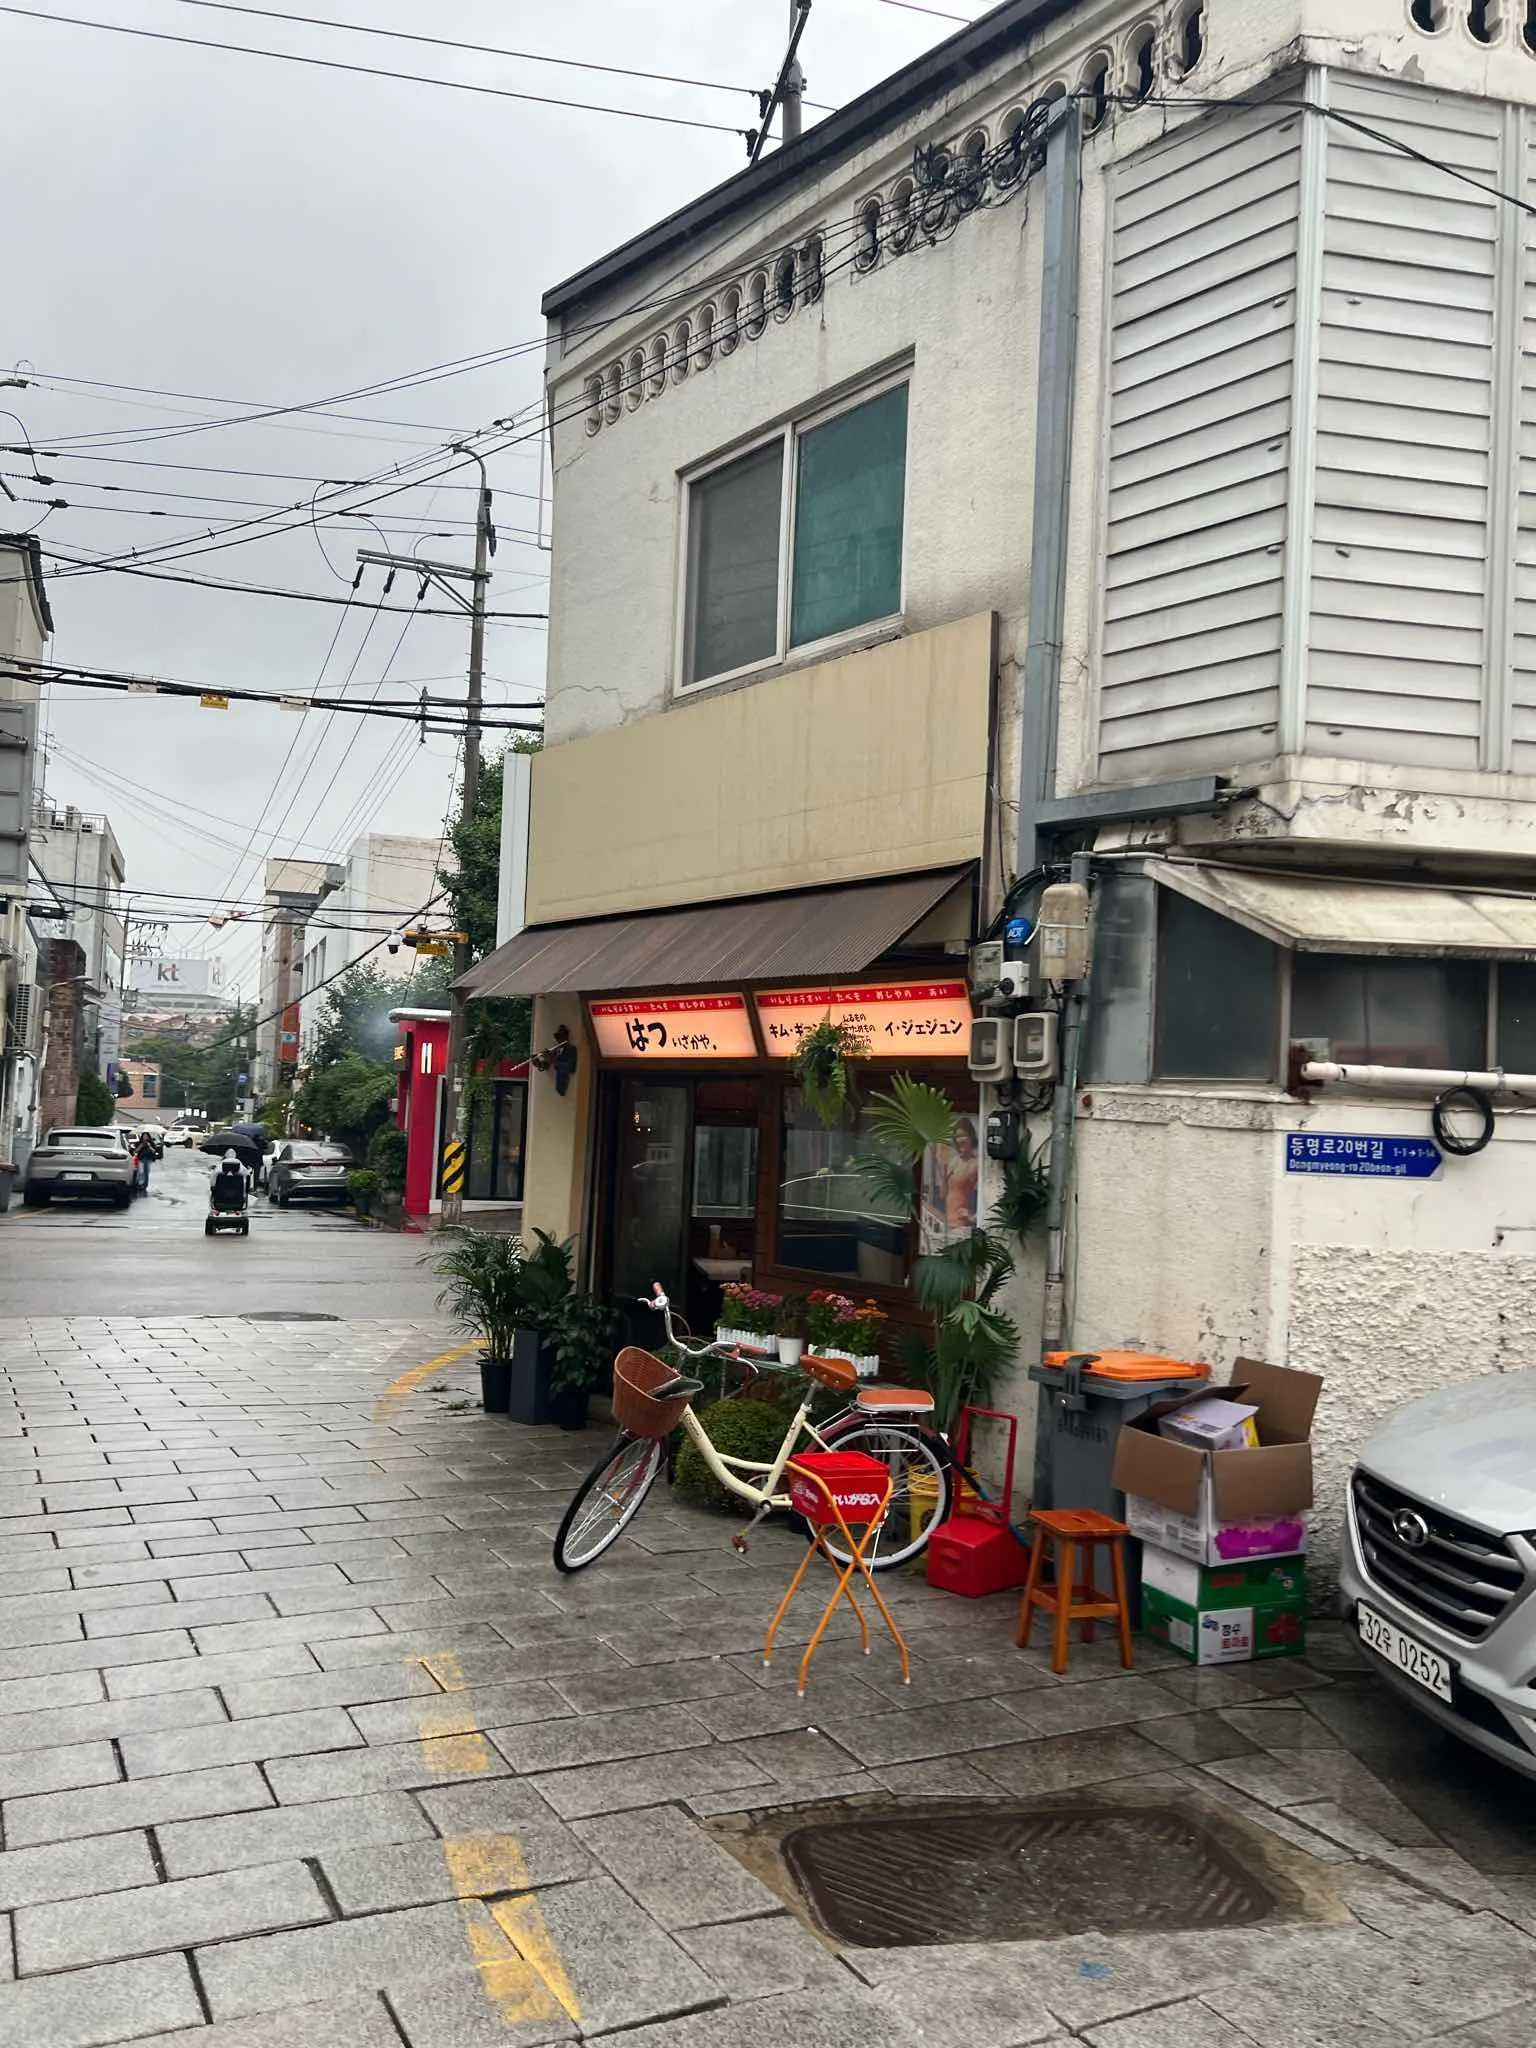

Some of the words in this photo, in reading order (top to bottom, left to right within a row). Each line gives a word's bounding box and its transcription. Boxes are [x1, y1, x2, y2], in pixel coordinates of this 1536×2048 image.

[157, 963, 180, 982] kt
[625, 1018, 668, 1052] はつ
[1289, 1159, 1358, 1173] Dongmyeong-ro
[1359, 1162, 1407, 1175] 20beon-gil
[1364, 1612, 1392, 1653] 32우
[1399, 1637, 1443, 1691] 0252
